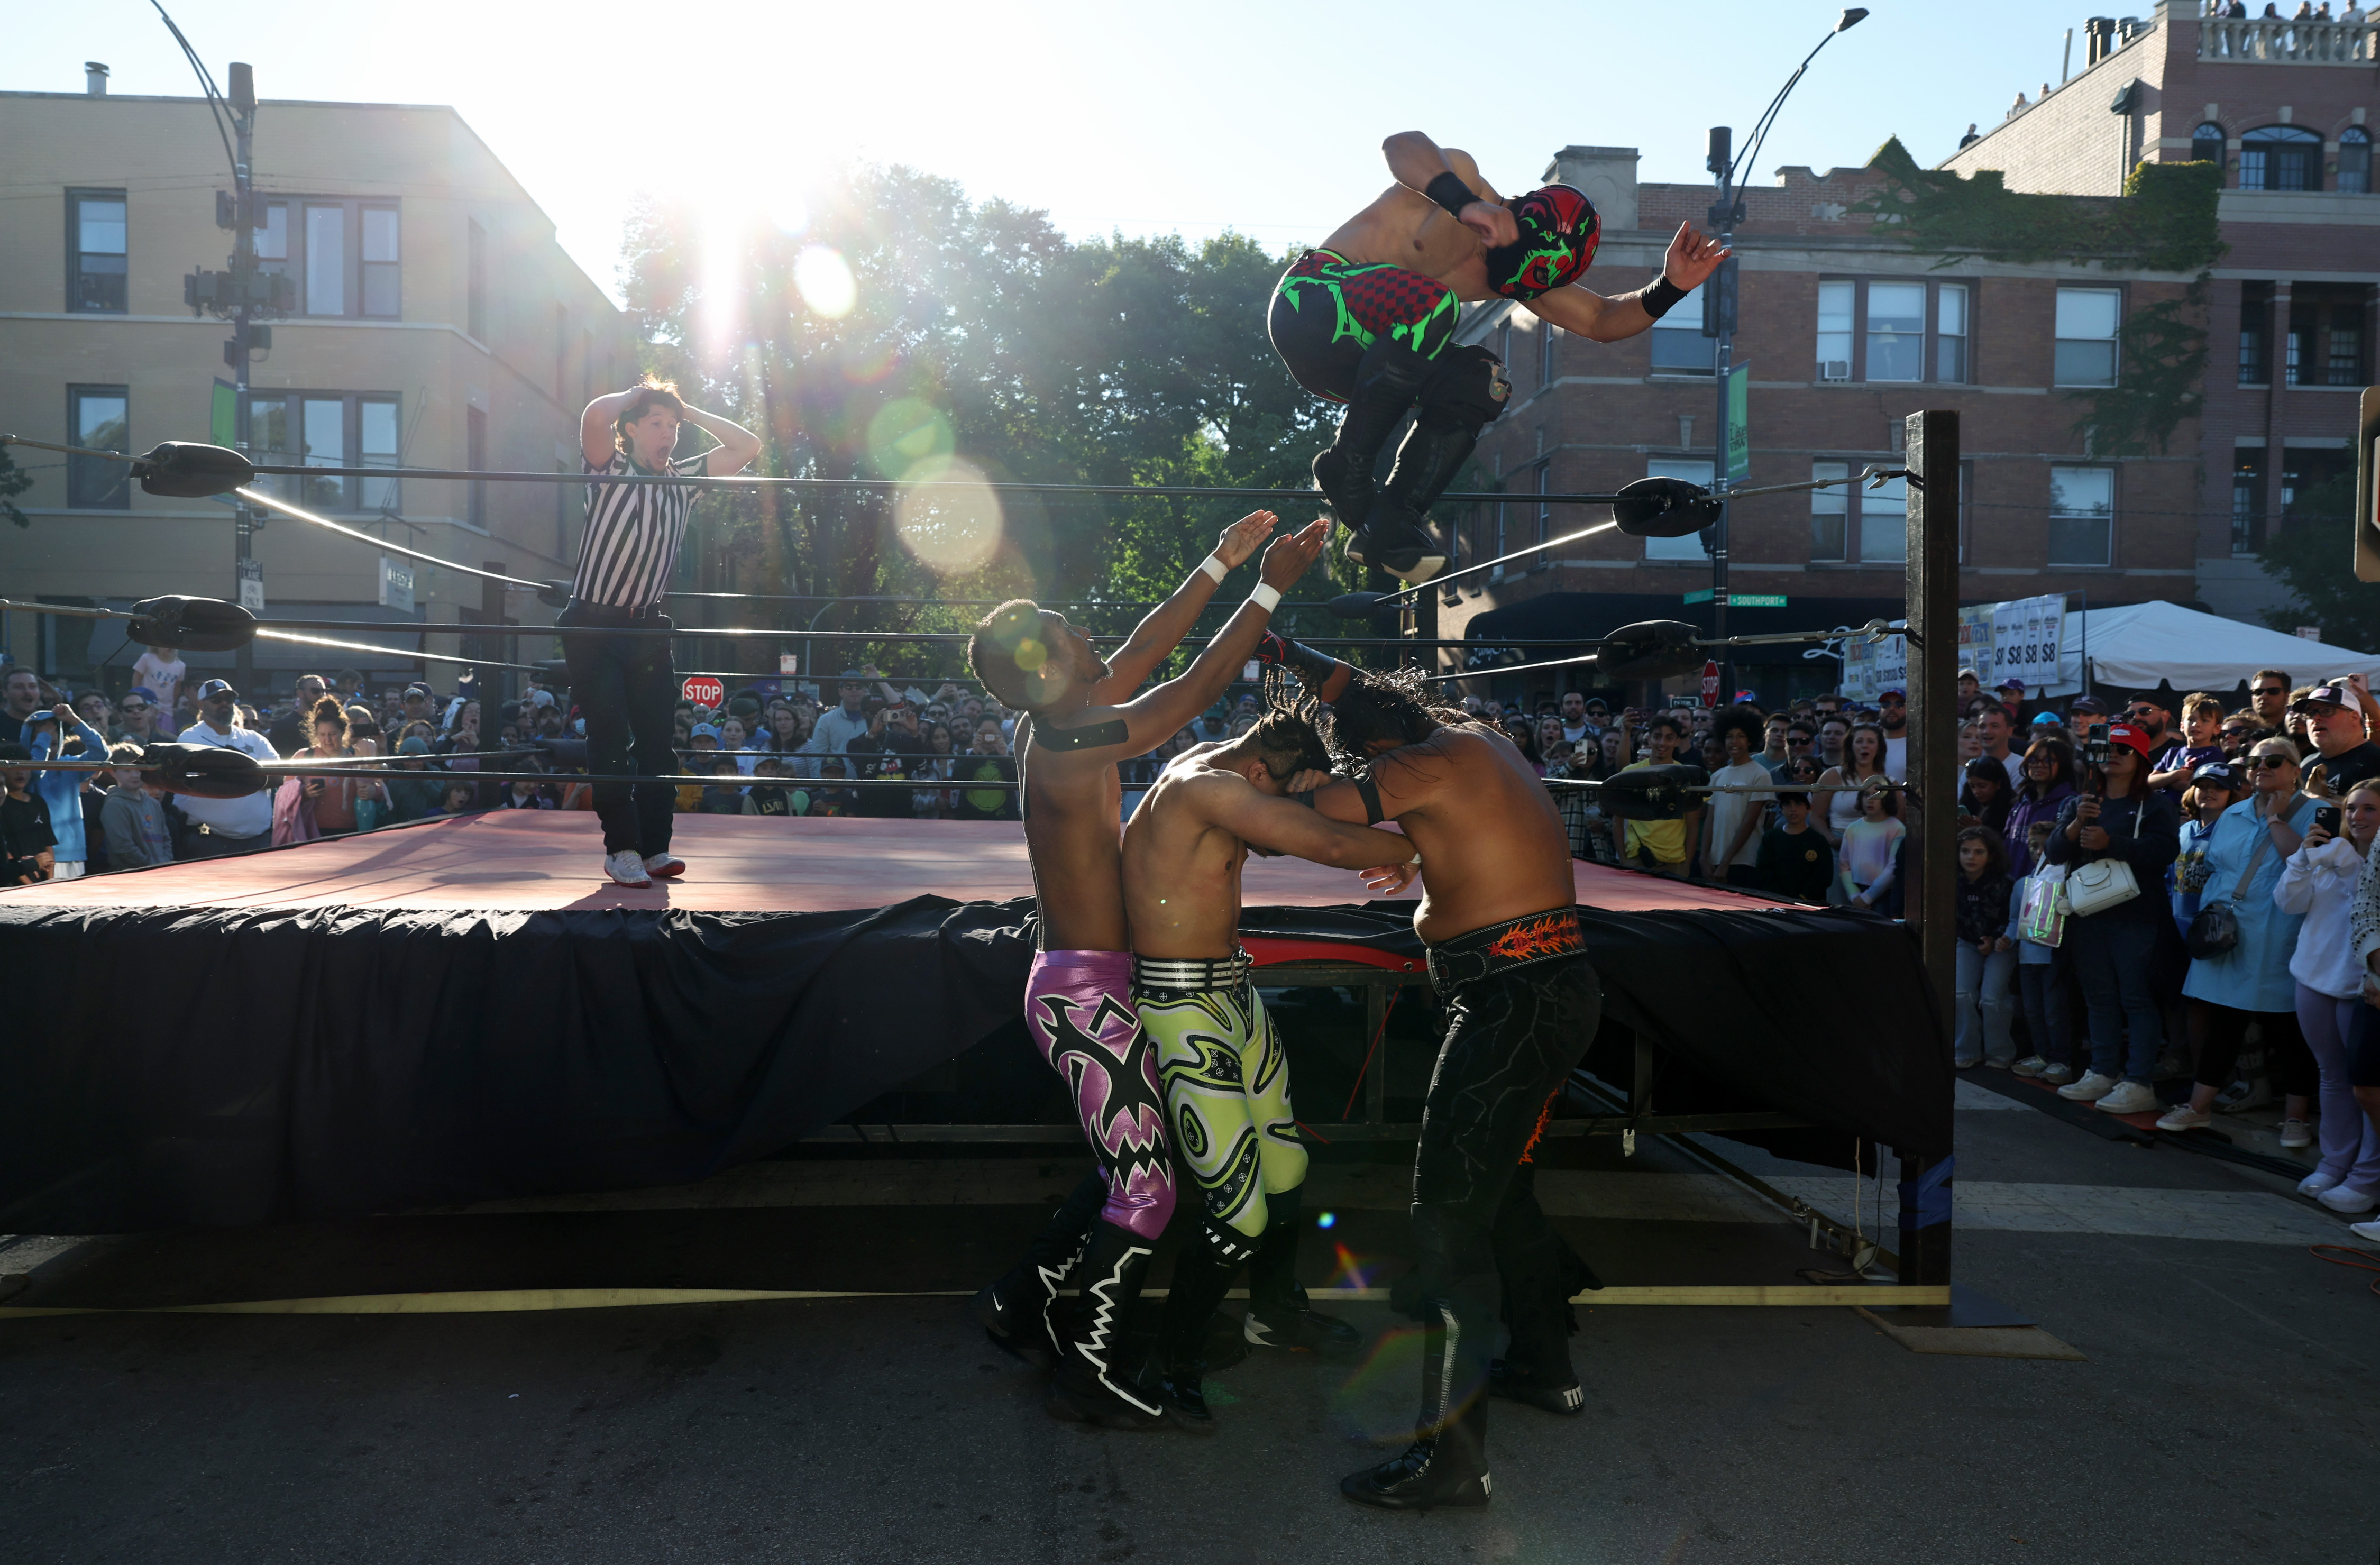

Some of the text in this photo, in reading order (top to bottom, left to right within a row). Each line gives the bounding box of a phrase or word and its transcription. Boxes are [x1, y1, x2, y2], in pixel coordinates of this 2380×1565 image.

[1737, 596, 1779, 605] SOUTHPORT
[2008, 645, 2022, 666] $8
[2025, 644, 2037, 664] $8
[2042, 642, 2055, 664] $8
[685, 684, 721, 701] STOP
[1702, 676, 1718, 694] STOP
[1563, 1384, 1584, 1407] TIT
